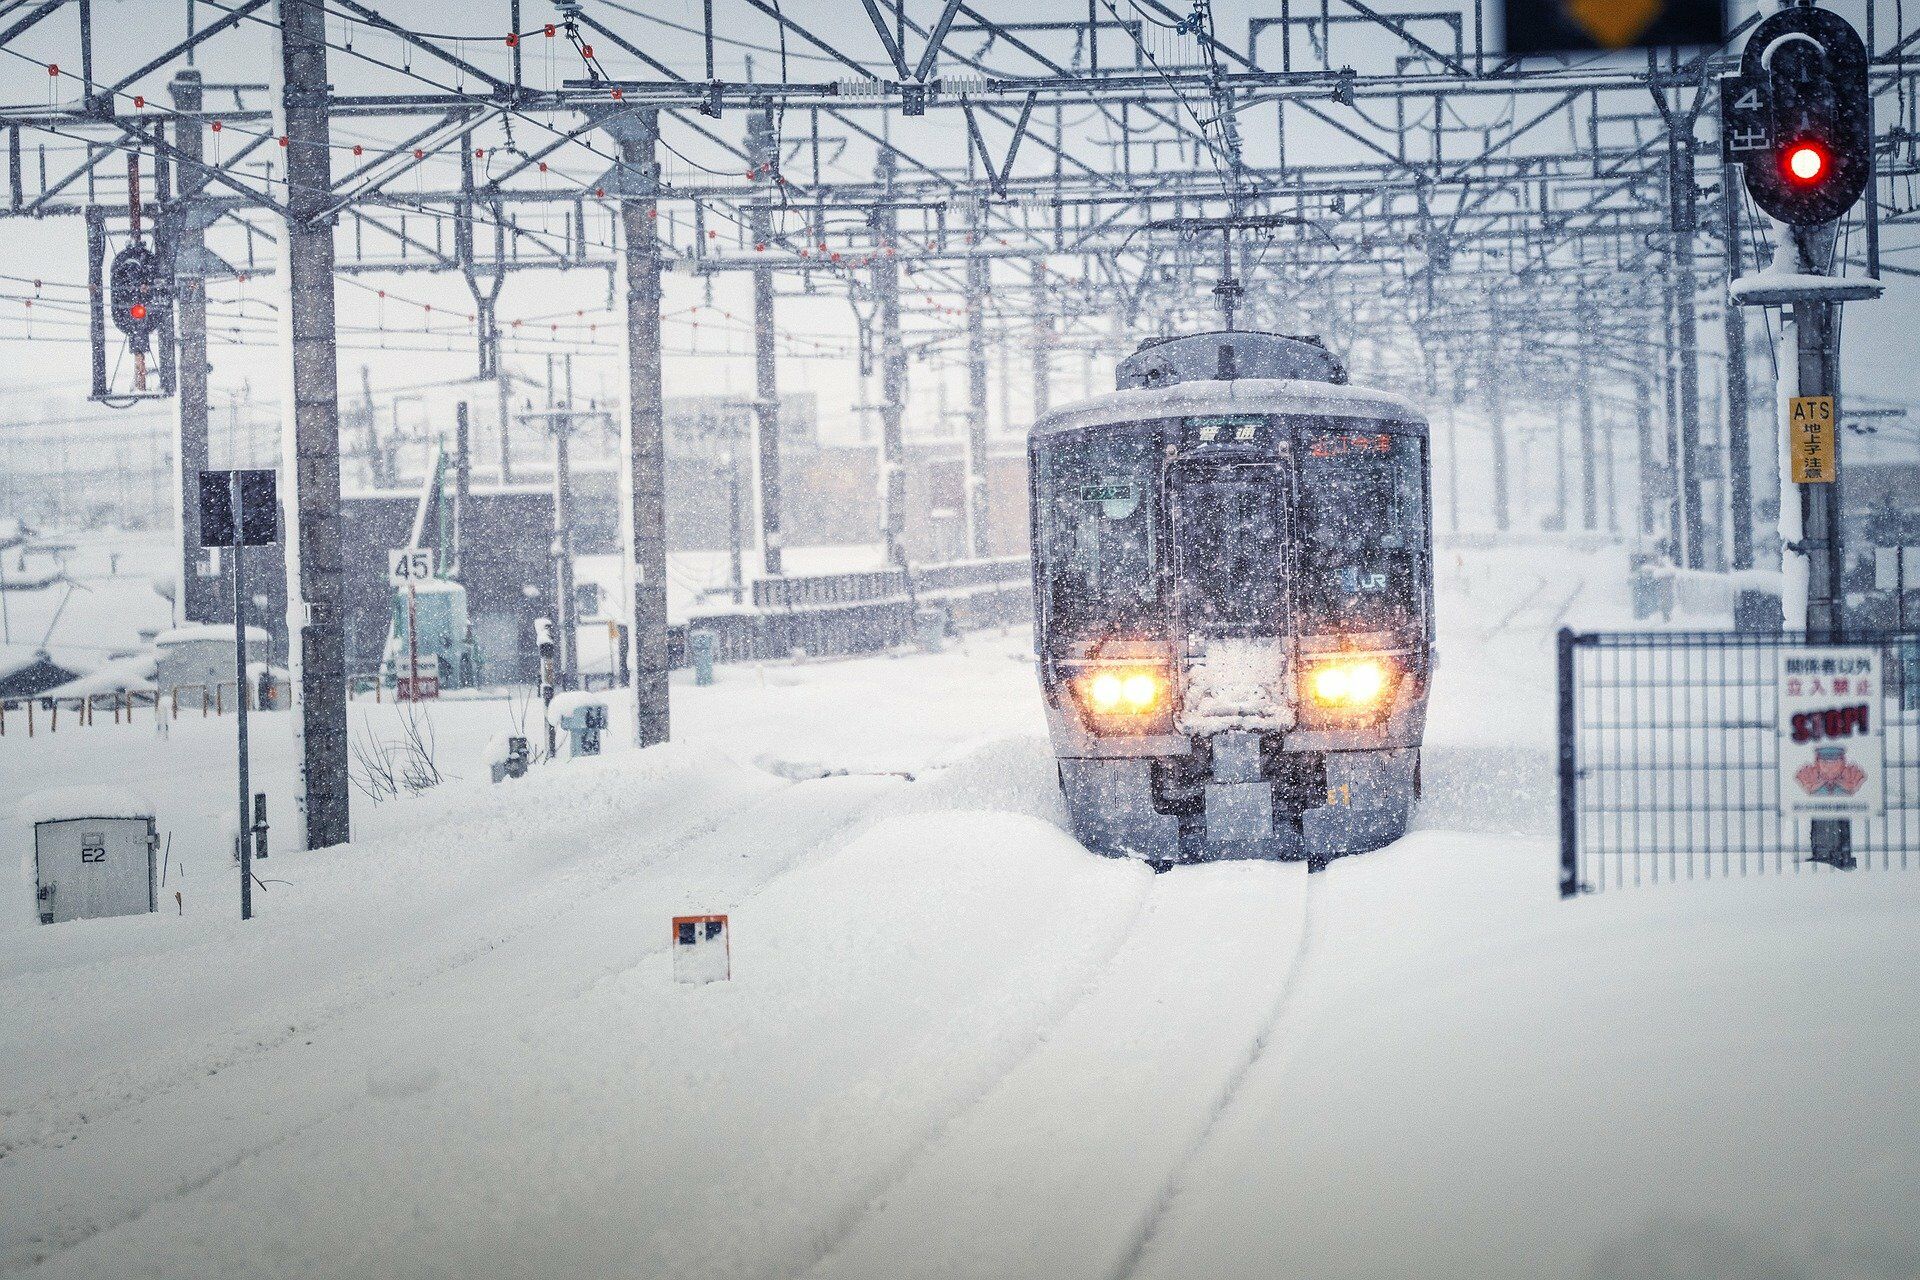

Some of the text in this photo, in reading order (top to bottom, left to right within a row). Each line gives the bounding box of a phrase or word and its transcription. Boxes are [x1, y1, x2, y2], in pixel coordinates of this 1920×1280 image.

[1794, 401, 1830, 420] ATS
[1200, 424, 1257, 441] 普通
[1803, 423, 1822, 478] 地上子注意
[395, 553, 429, 580] 45
[1361, 573, 1386, 589] JR
[1786, 657, 1871, 674] 関係者以外
[1787, 676, 1872, 696] 立入禁止
[82, 848, 105, 863] E2
